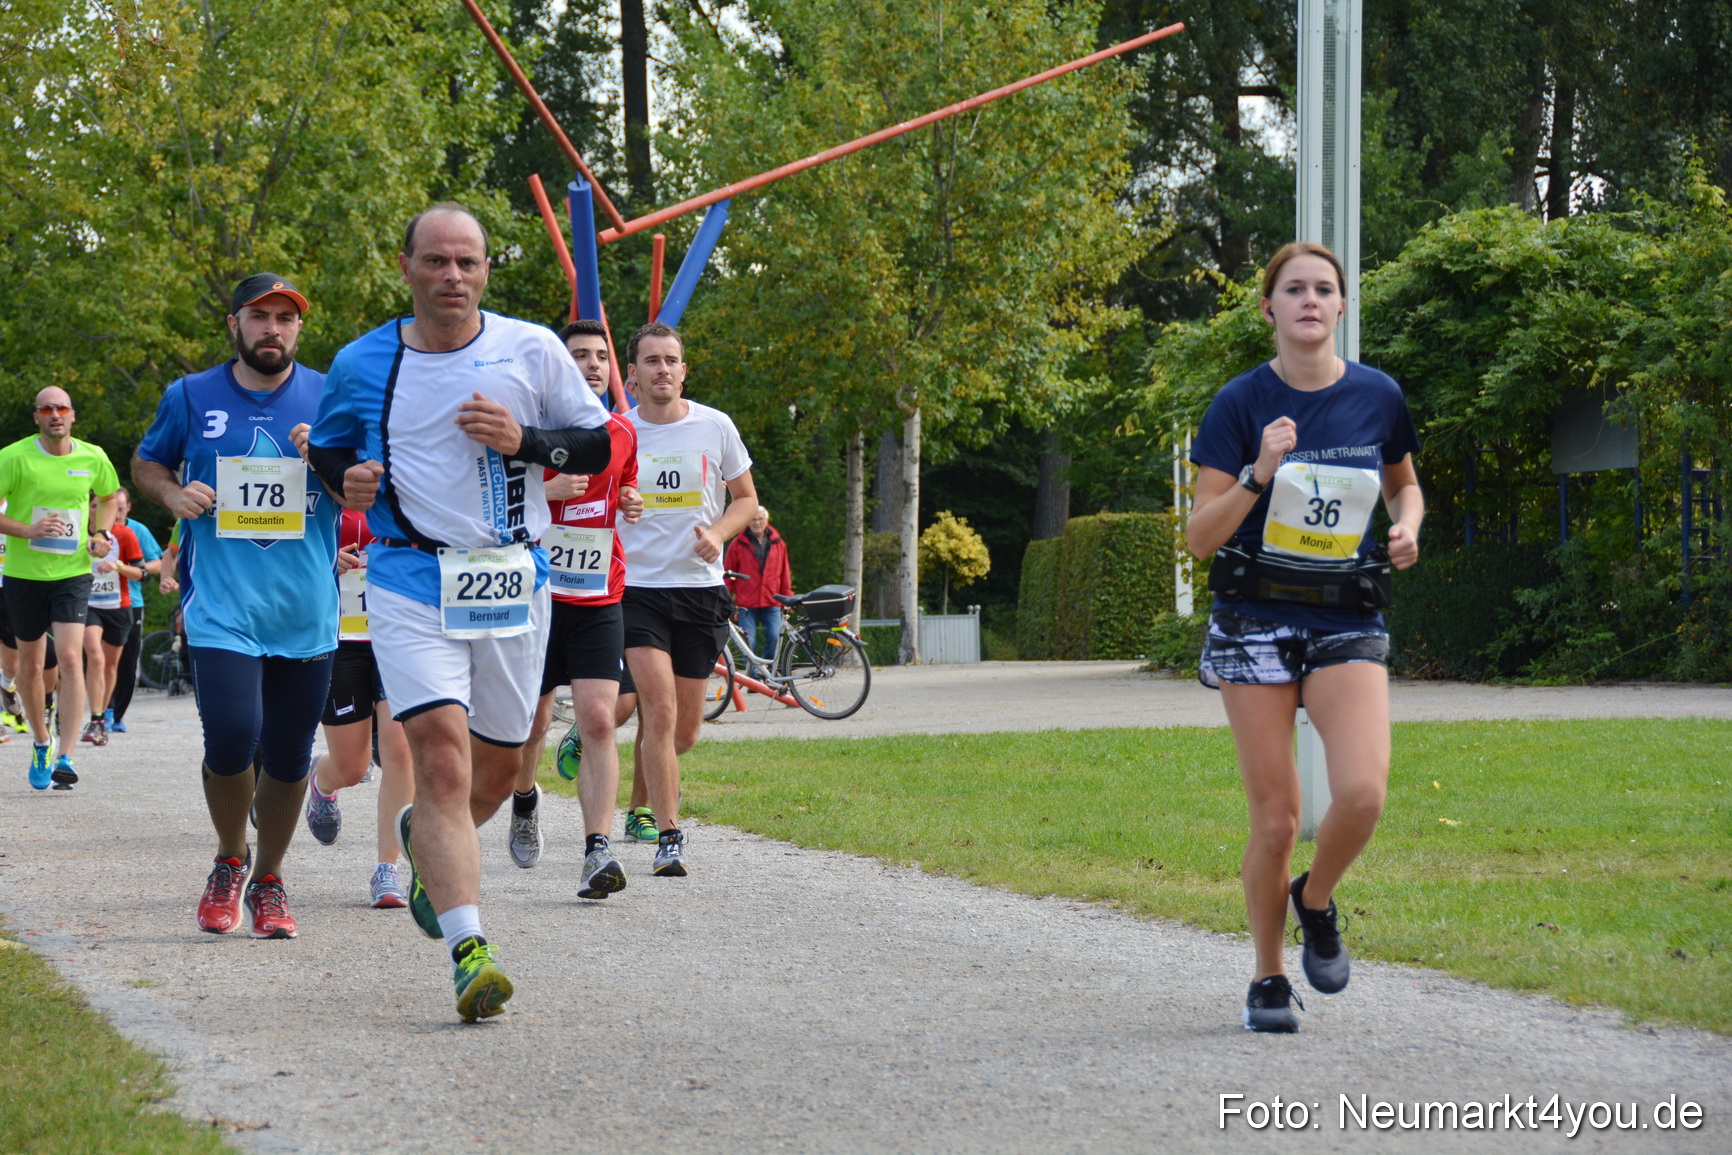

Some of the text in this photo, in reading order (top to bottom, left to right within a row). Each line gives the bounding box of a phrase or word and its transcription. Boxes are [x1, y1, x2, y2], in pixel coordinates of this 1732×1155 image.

[202, 410, 229, 438] 3
[1321, 446, 1377, 460] METRAWATT
[476, 456, 491, 522] WASTE WATER
[656, 470, 681, 489] 40
[238, 482, 285, 507] 178
[490, 452, 508, 535] TECHNOL
[502, 453, 530, 544] UBER
[237, 515, 284, 525] Constantin
[576, 507, 595, 515] DEHN
[1303, 497, 1342, 528] 36
[1299, 535, 1333, 550] Monja
[550, 546, 601, 570] 2112
[457, 571, 522, 600] 2238
[559, 574, 585, 584] Florian
[469, 610, 510, 621] Bernhard
